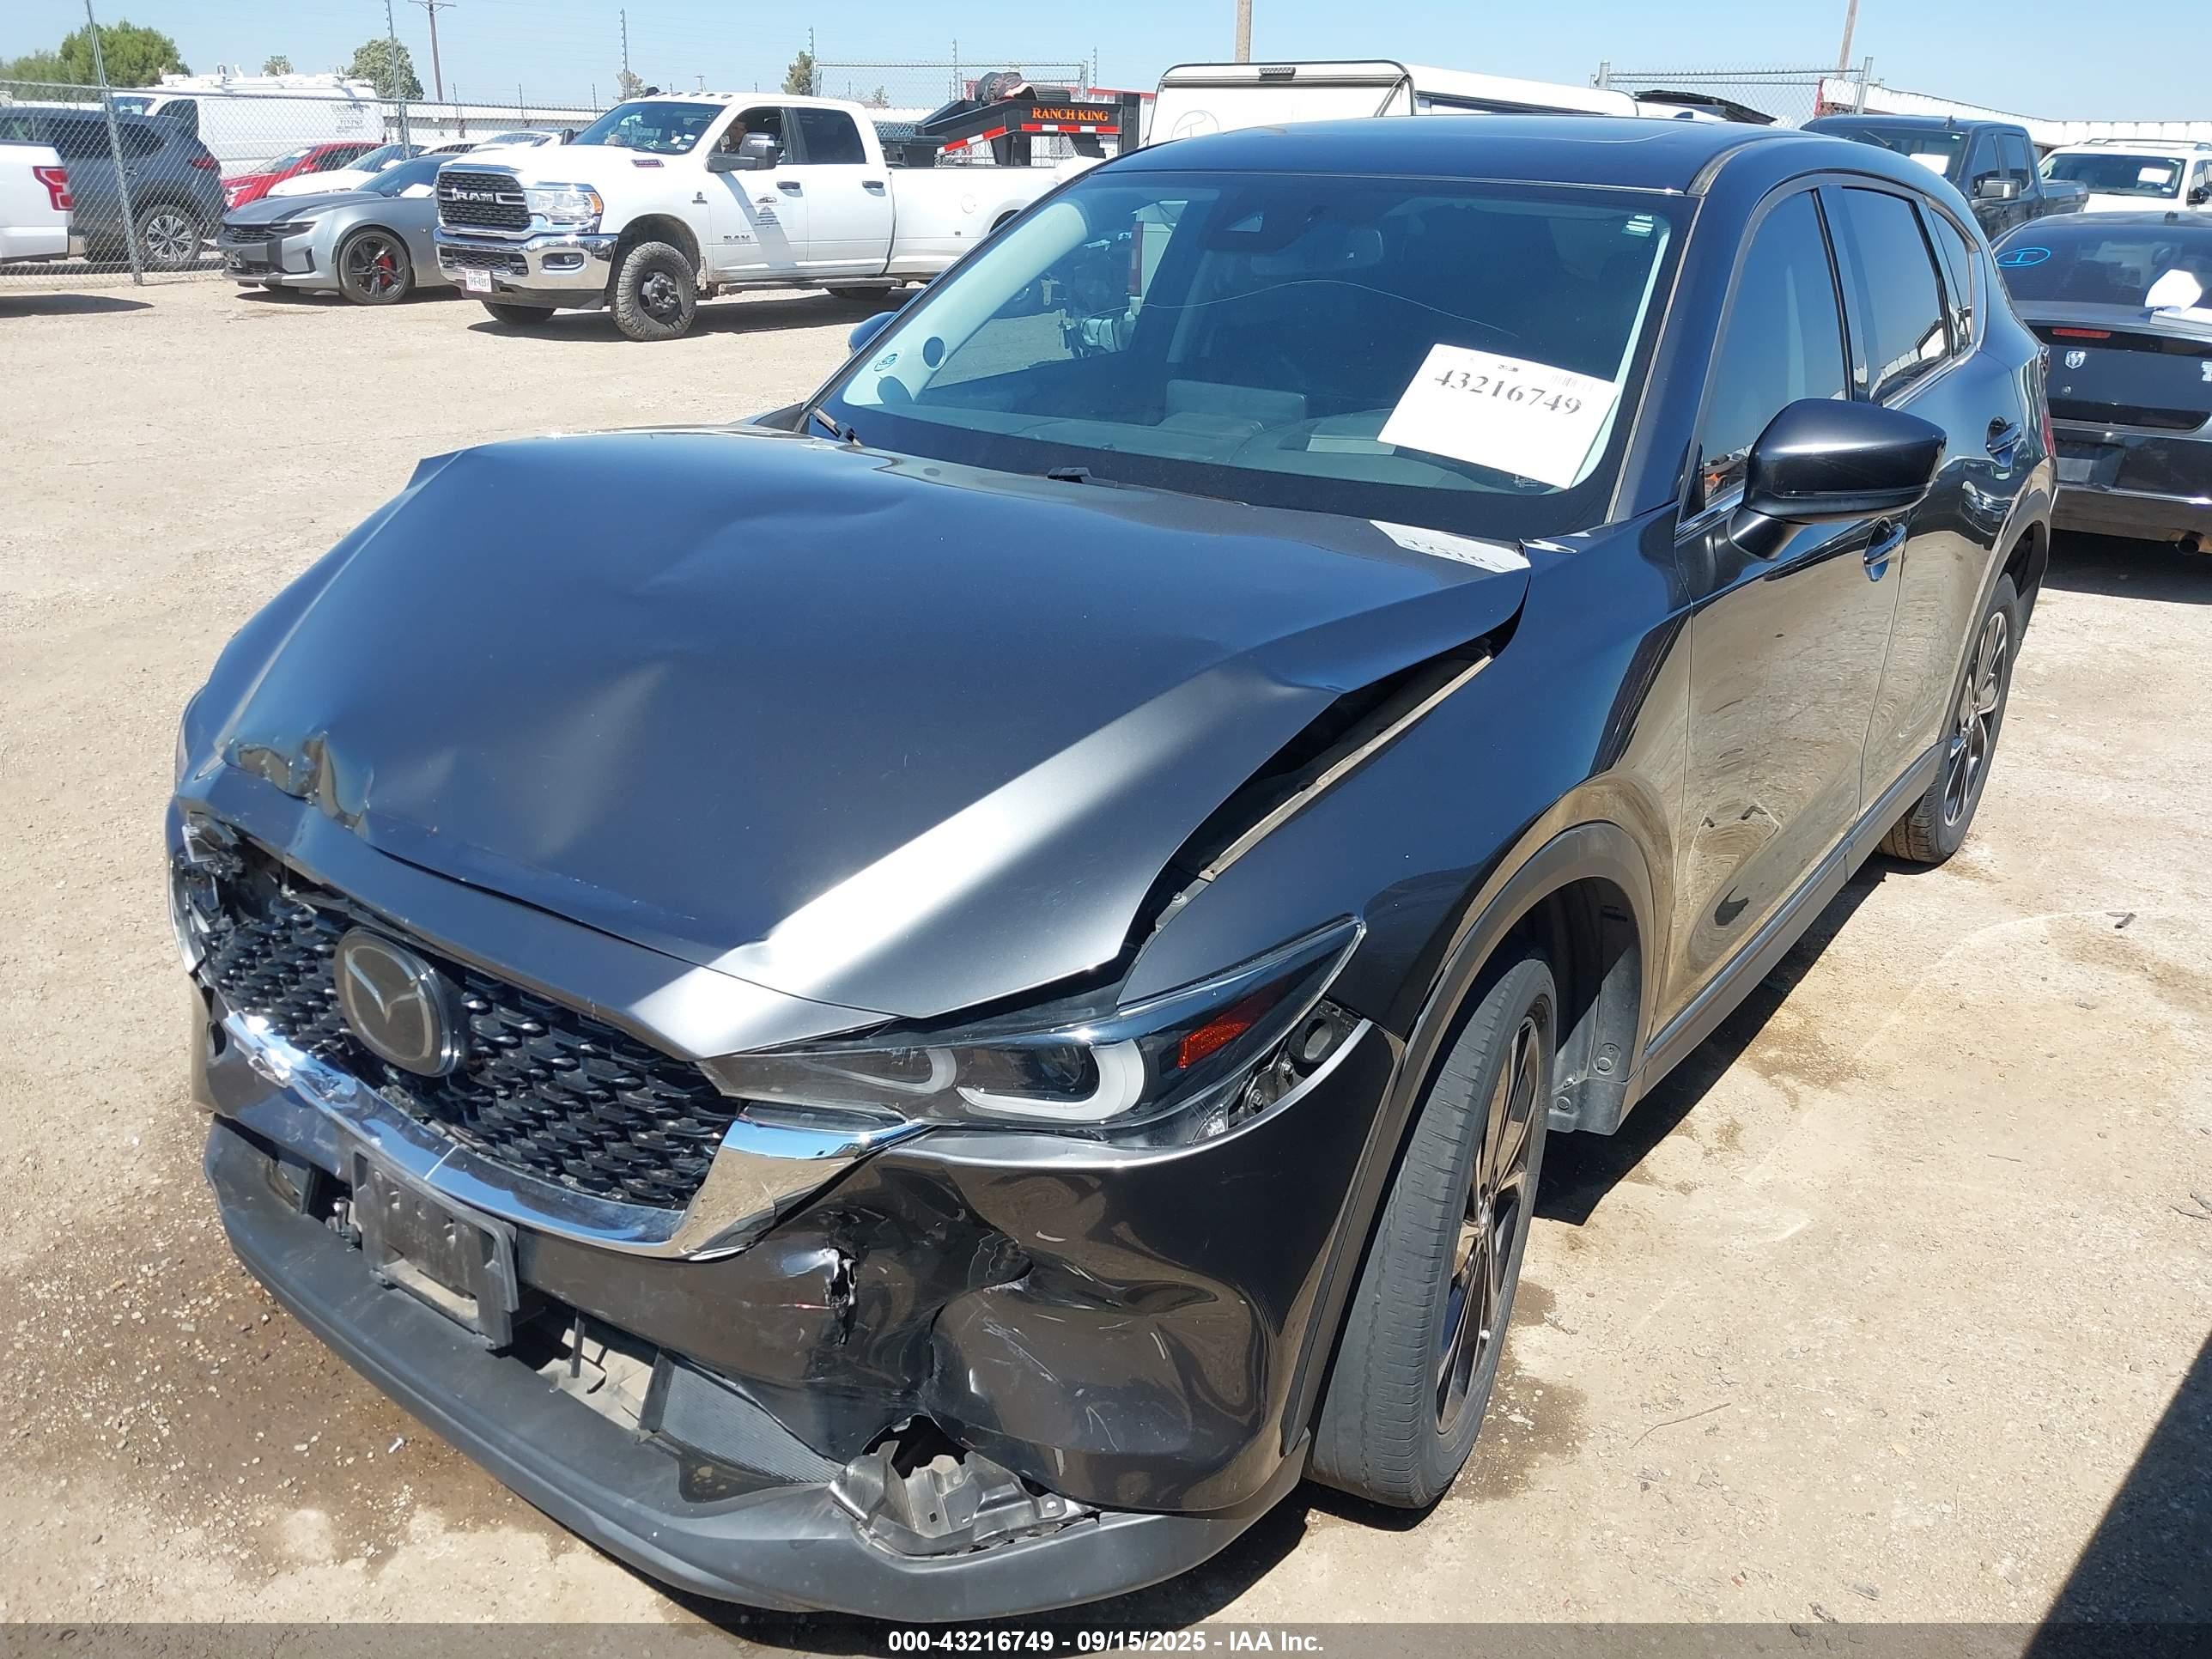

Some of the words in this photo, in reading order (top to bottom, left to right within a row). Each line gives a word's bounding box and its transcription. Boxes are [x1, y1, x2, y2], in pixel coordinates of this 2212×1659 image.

[1031, 107, 1076, 120] RANCH
[1078, 109, 1109, 121] KING
[456, 191, 495, 203] RAM
[1433, 368, 1582, 415] 43216749
